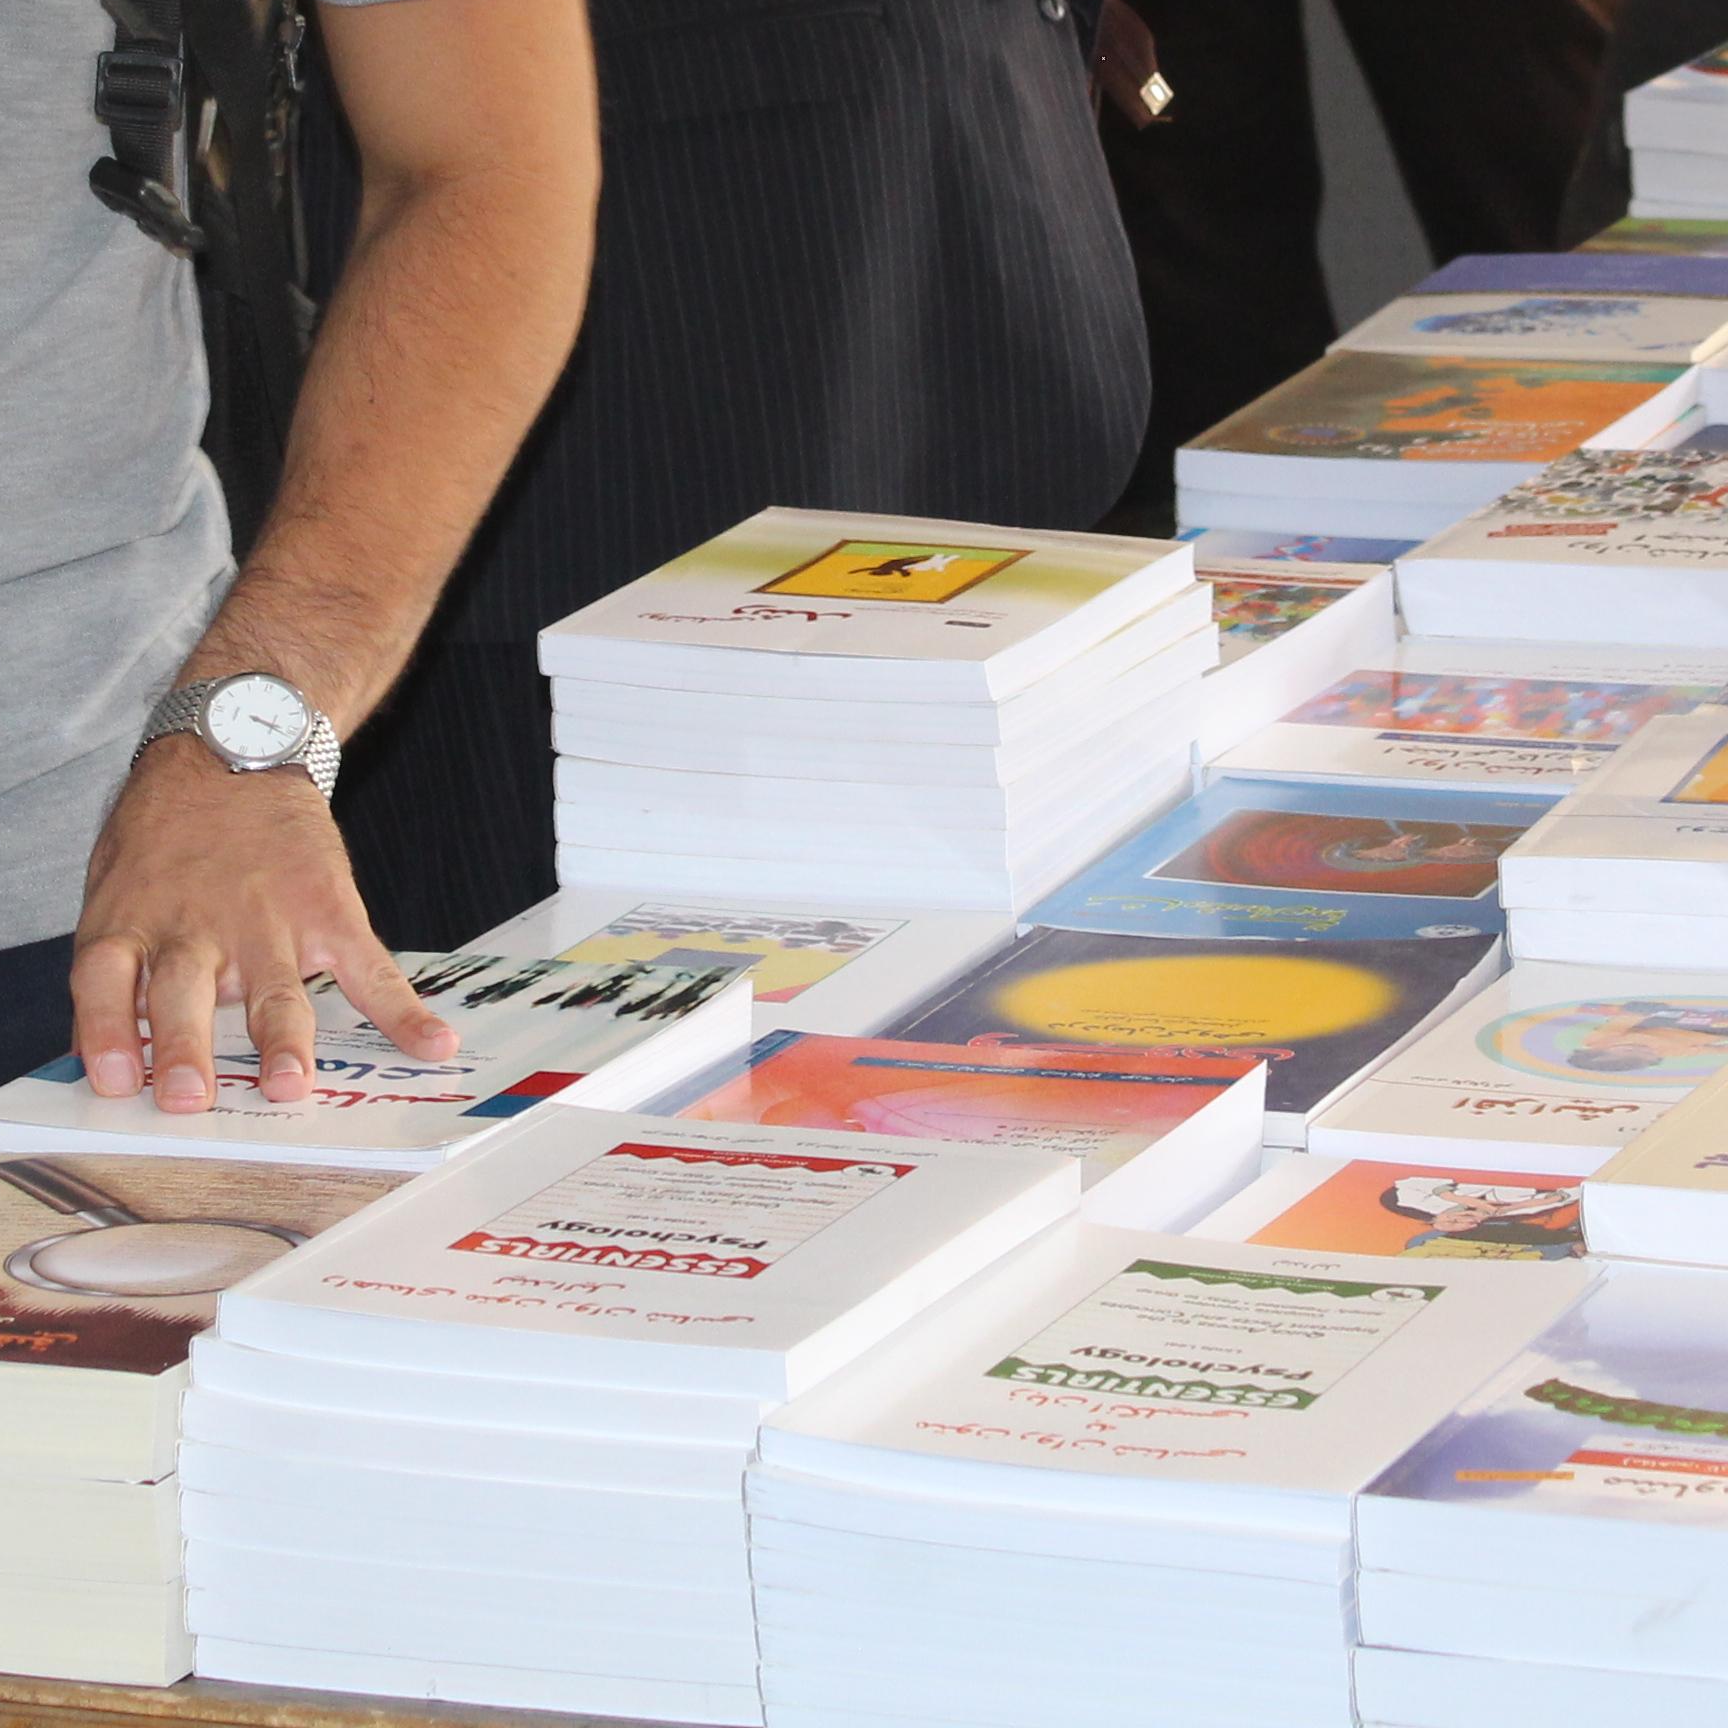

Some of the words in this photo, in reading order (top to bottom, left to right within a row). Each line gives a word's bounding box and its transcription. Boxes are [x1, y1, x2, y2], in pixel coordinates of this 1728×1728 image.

[1453, 1096, 1640, 1122] افزایش
[537, 1220, 768, 1251] Psychology
[474, 1239, 751, 1276] ESSENTIALS
[321, 1276, 455, 1301] راهنمای
[465, 1293, 545, 1309] متون
[1070, 1345, 1314, 1382] Psychology
[1009, 1365, 1299, 1408] ESSENTIALS
[1008, 1387, 1088, 1410] زبان
[1092, 1402, 1250, 1421] انگلیسی
[915, 1421, 1011, 1441] متون
[1085, 1421, 1118, 1433] به
